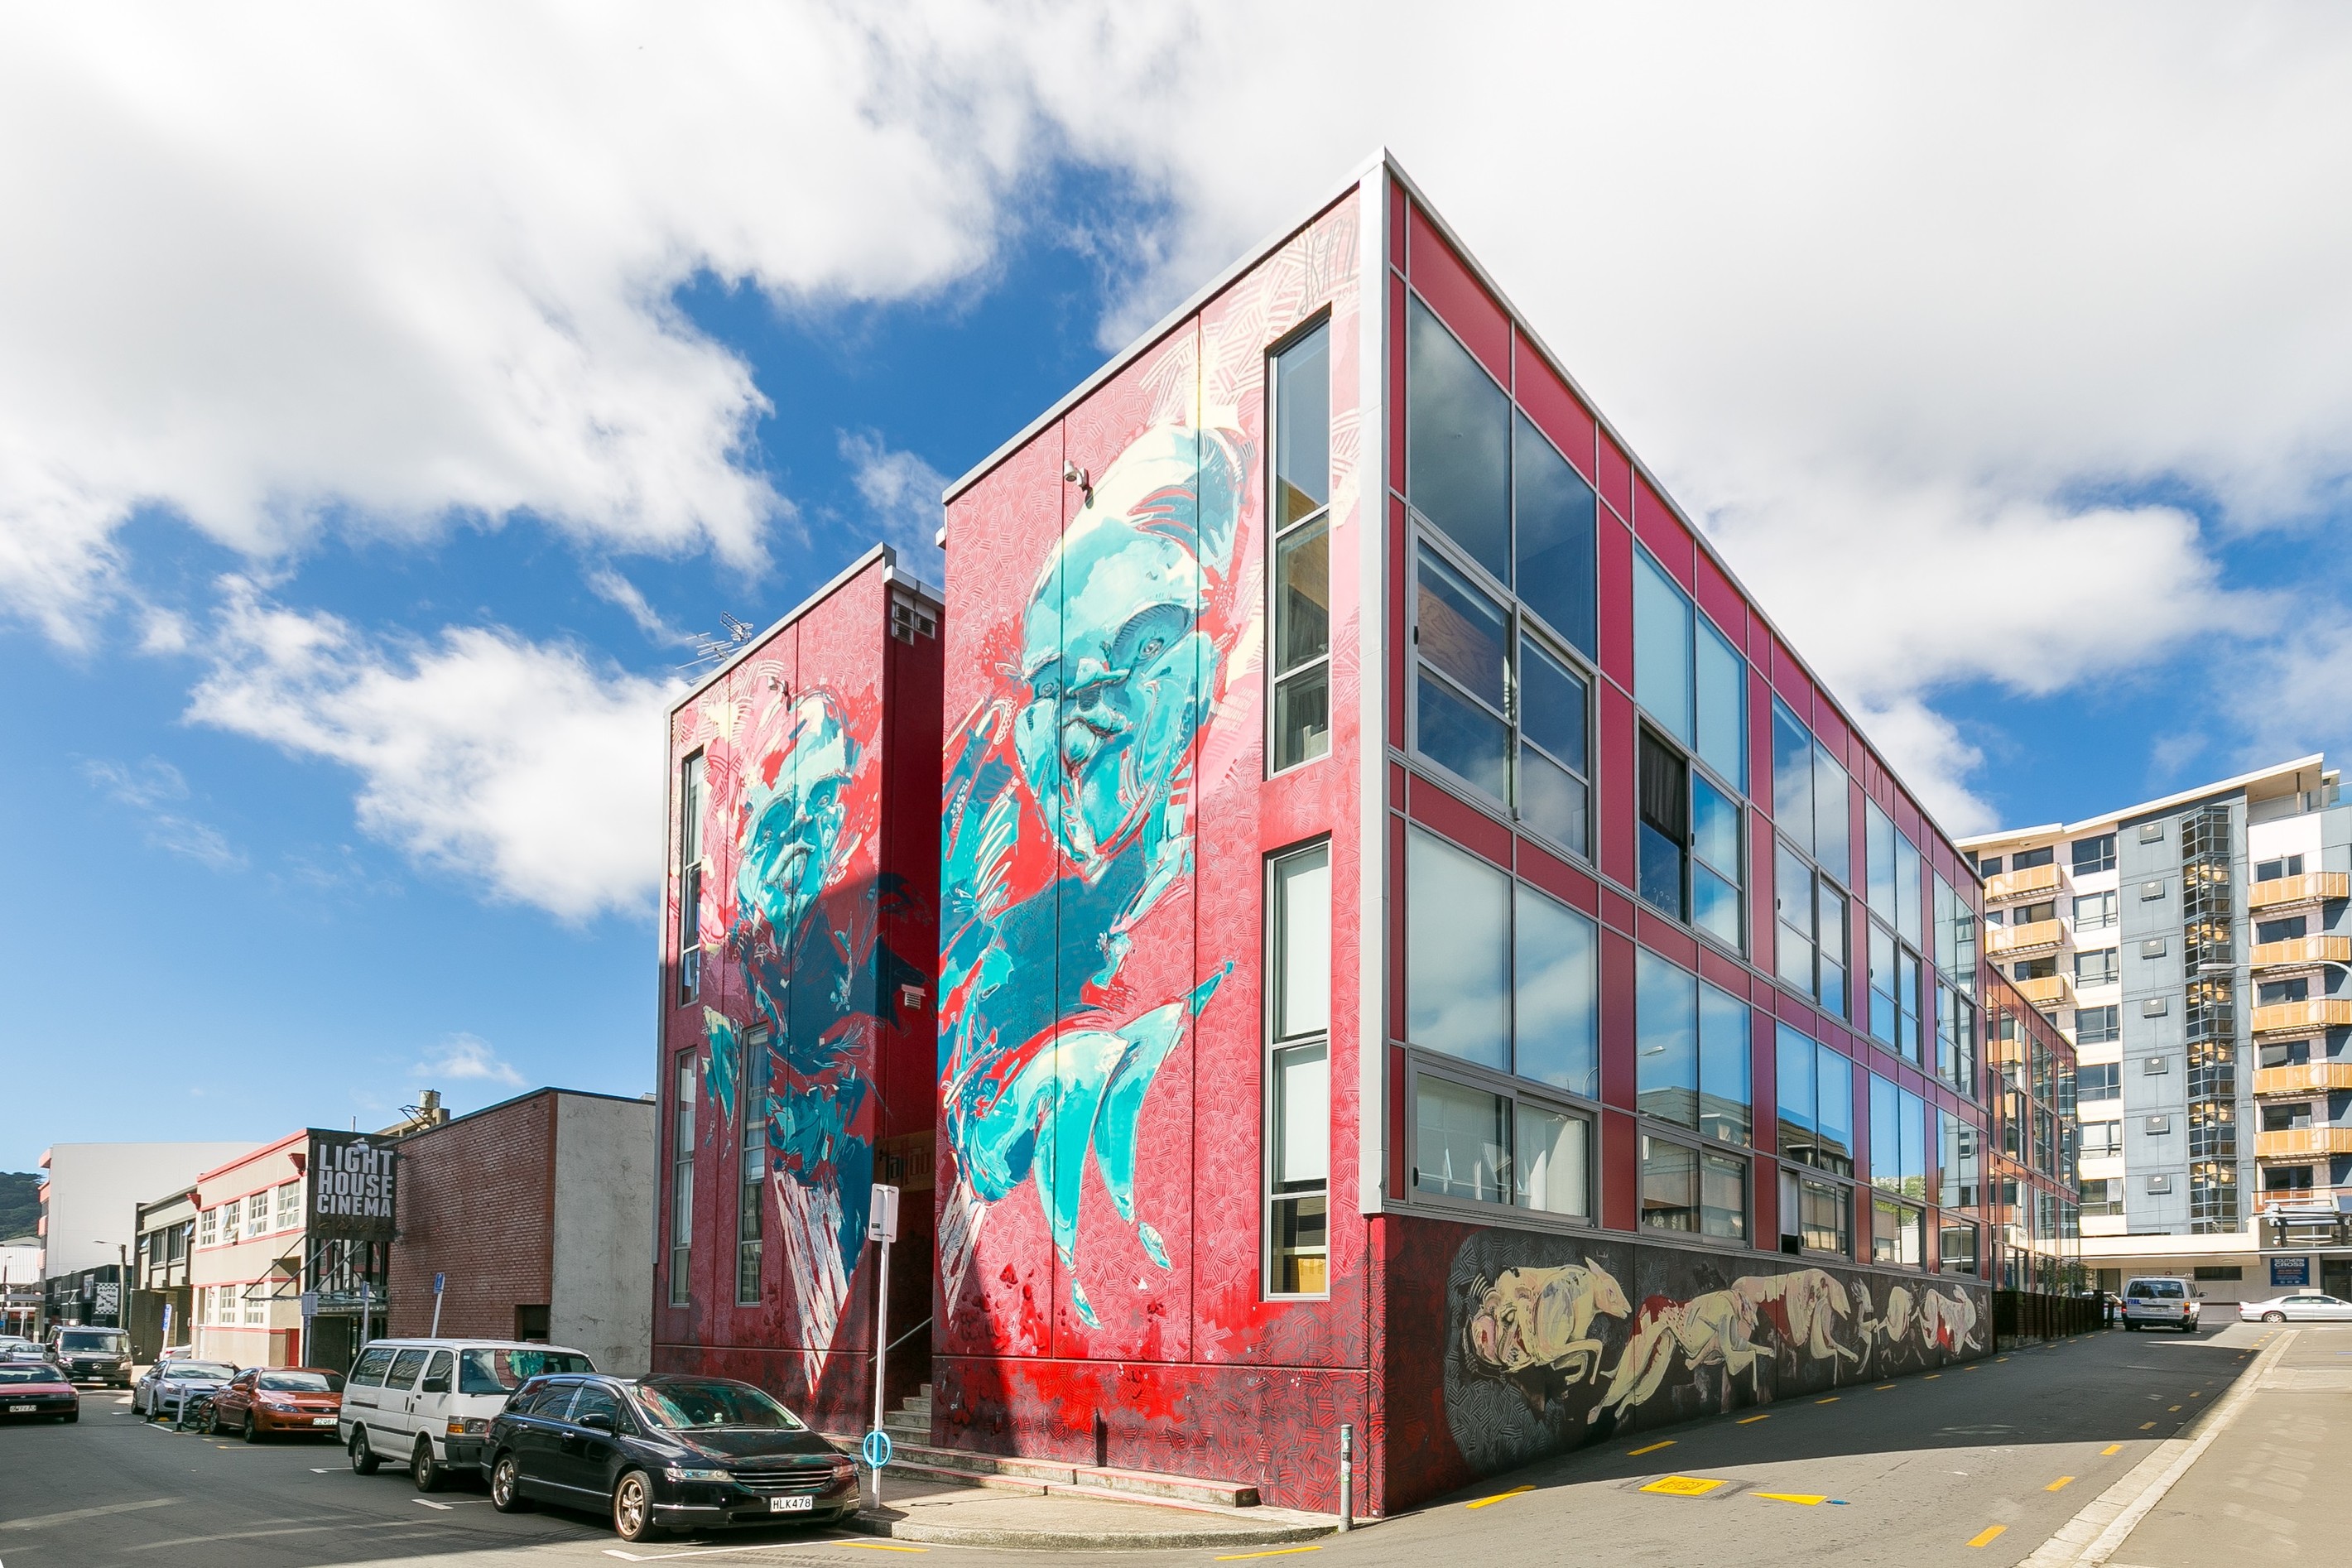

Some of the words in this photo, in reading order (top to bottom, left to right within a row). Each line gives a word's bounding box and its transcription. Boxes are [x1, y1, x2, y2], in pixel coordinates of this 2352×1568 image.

[319, 1144, 394, 1175] LIGHT
[318, 1170, 393, 1199] HOUSE
[316, 1194, 392, 1218] CINEMA
[772, 1498, 811, 1510] HLK478
